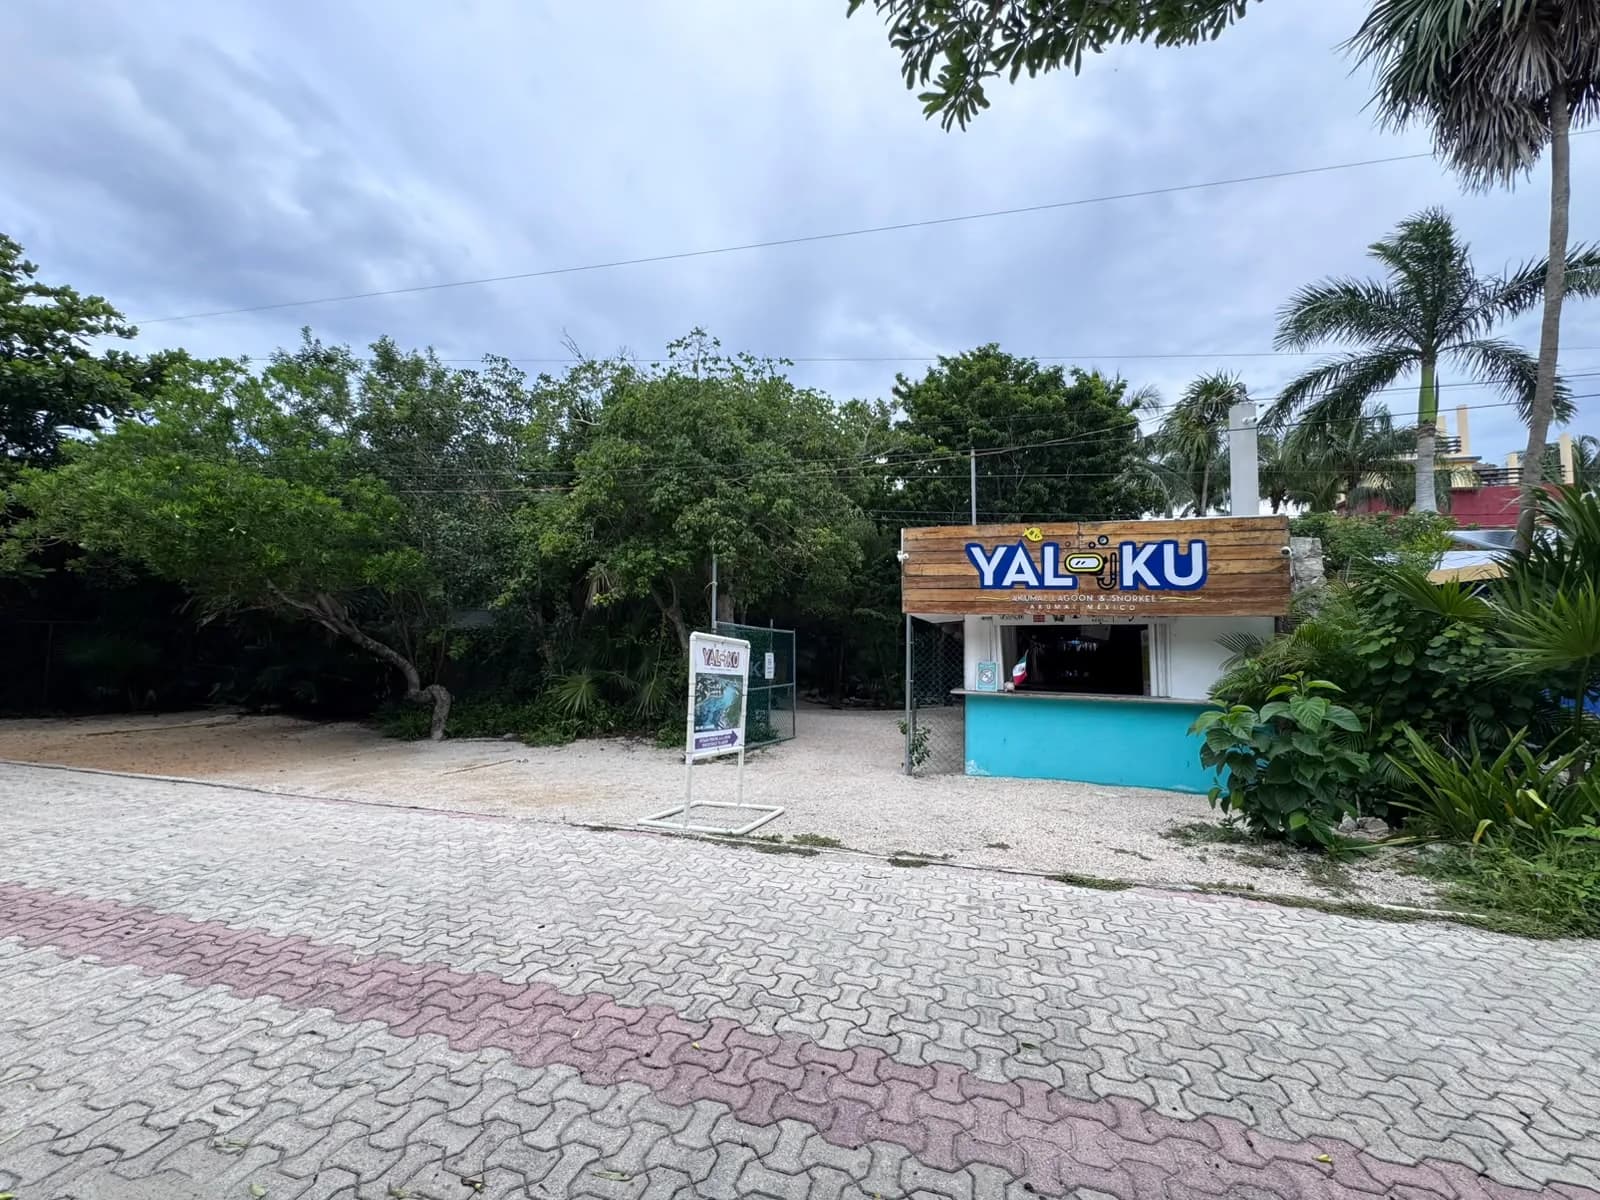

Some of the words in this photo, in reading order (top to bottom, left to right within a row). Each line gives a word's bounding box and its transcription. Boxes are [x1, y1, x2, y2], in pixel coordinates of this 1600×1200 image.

[967, 542, 1076, 588] YAL
[1121, 541, 1205, 588] KU
[1050, 594, 1093, 602] LAGOON
[1099, 594, 1105, 602] &
[1111, 594, 1156, 602] SNORKEL
